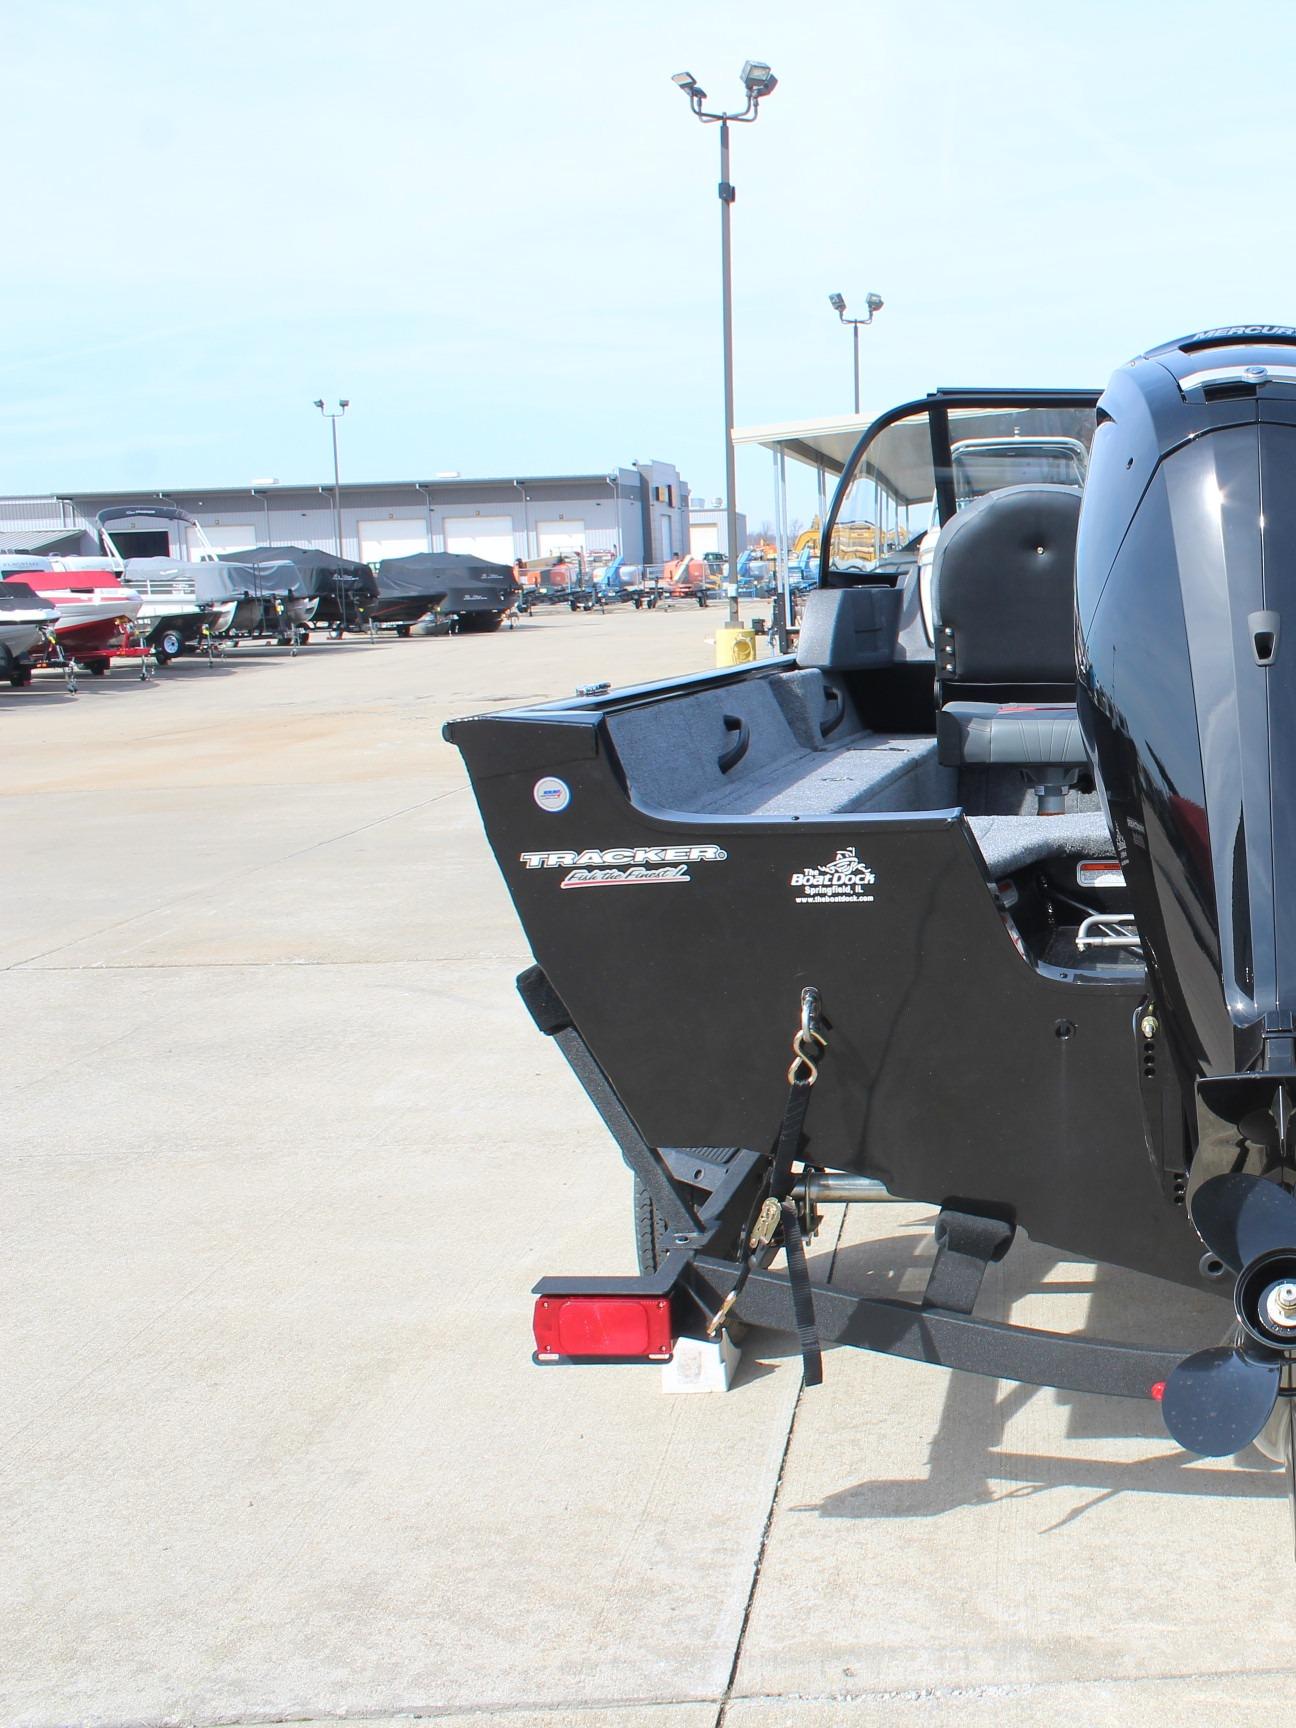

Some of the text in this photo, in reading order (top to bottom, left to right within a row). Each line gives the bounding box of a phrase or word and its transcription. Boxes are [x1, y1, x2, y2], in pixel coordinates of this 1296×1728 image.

[521, 846, 720, 868] TRACKER
[568, 869, 599, 881] Fish
[601, 868, 622, 880] the
[804, 868, 819, 876] The
[804, 885, 864, 895] Springfield, IL
[795, 895, 874, 903] www.theboatdock.com
